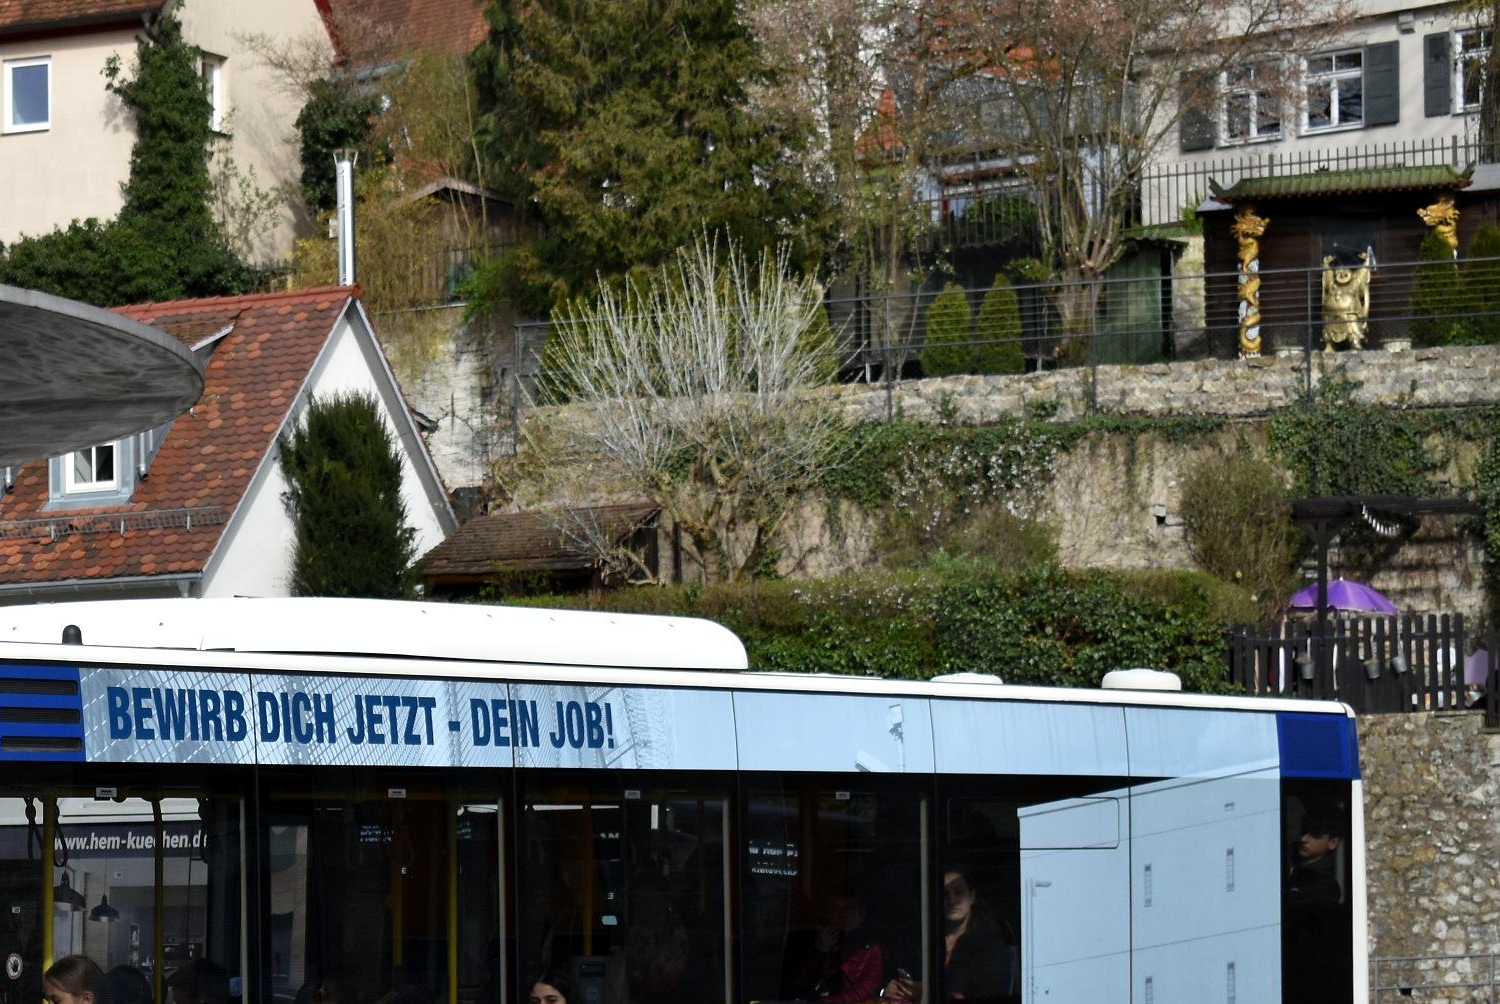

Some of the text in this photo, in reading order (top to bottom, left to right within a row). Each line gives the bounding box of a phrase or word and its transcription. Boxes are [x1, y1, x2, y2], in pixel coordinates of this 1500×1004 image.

[105, 686, 616, 750] BEWIRB DICH JETZT - DEIN JOB!
[54, 829, 207, 850] www.hem-kuehen.d
